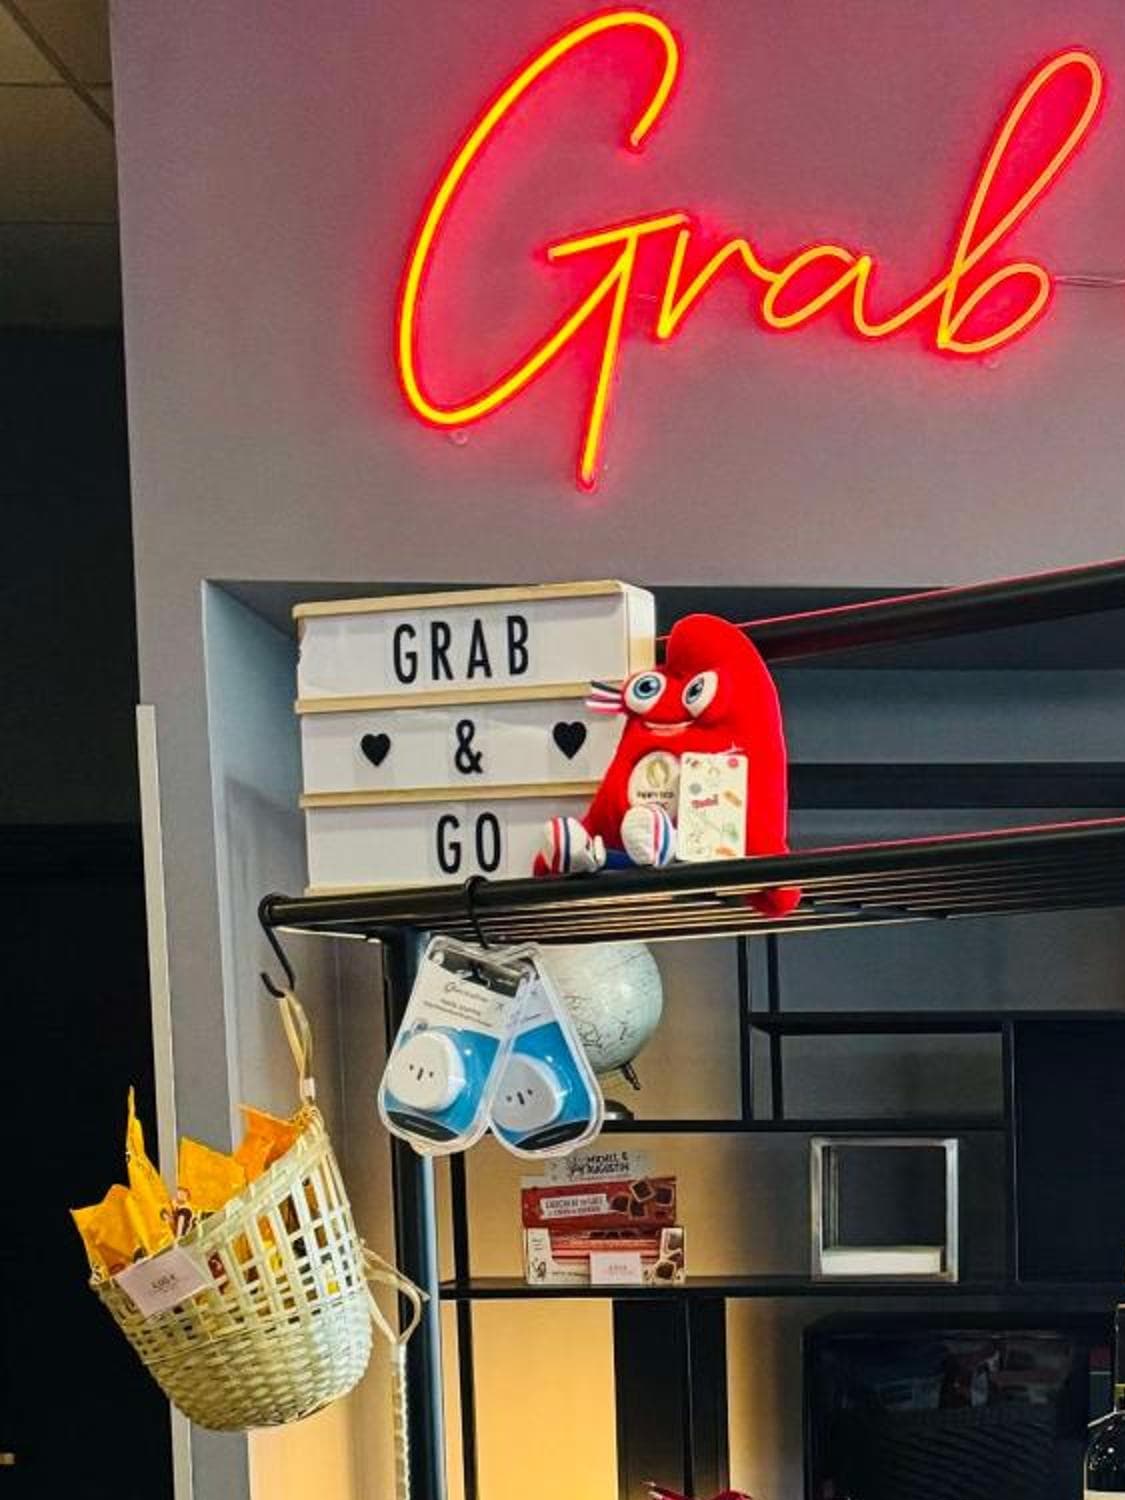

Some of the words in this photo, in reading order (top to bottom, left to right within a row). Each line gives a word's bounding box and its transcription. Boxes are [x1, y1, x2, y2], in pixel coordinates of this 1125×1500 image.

[398, 8, 1106, 484] Grab
[393, 614, 529, 684] GRAB
[454, 718, 483, 774] &
[436, 811, 501, 874] GO
